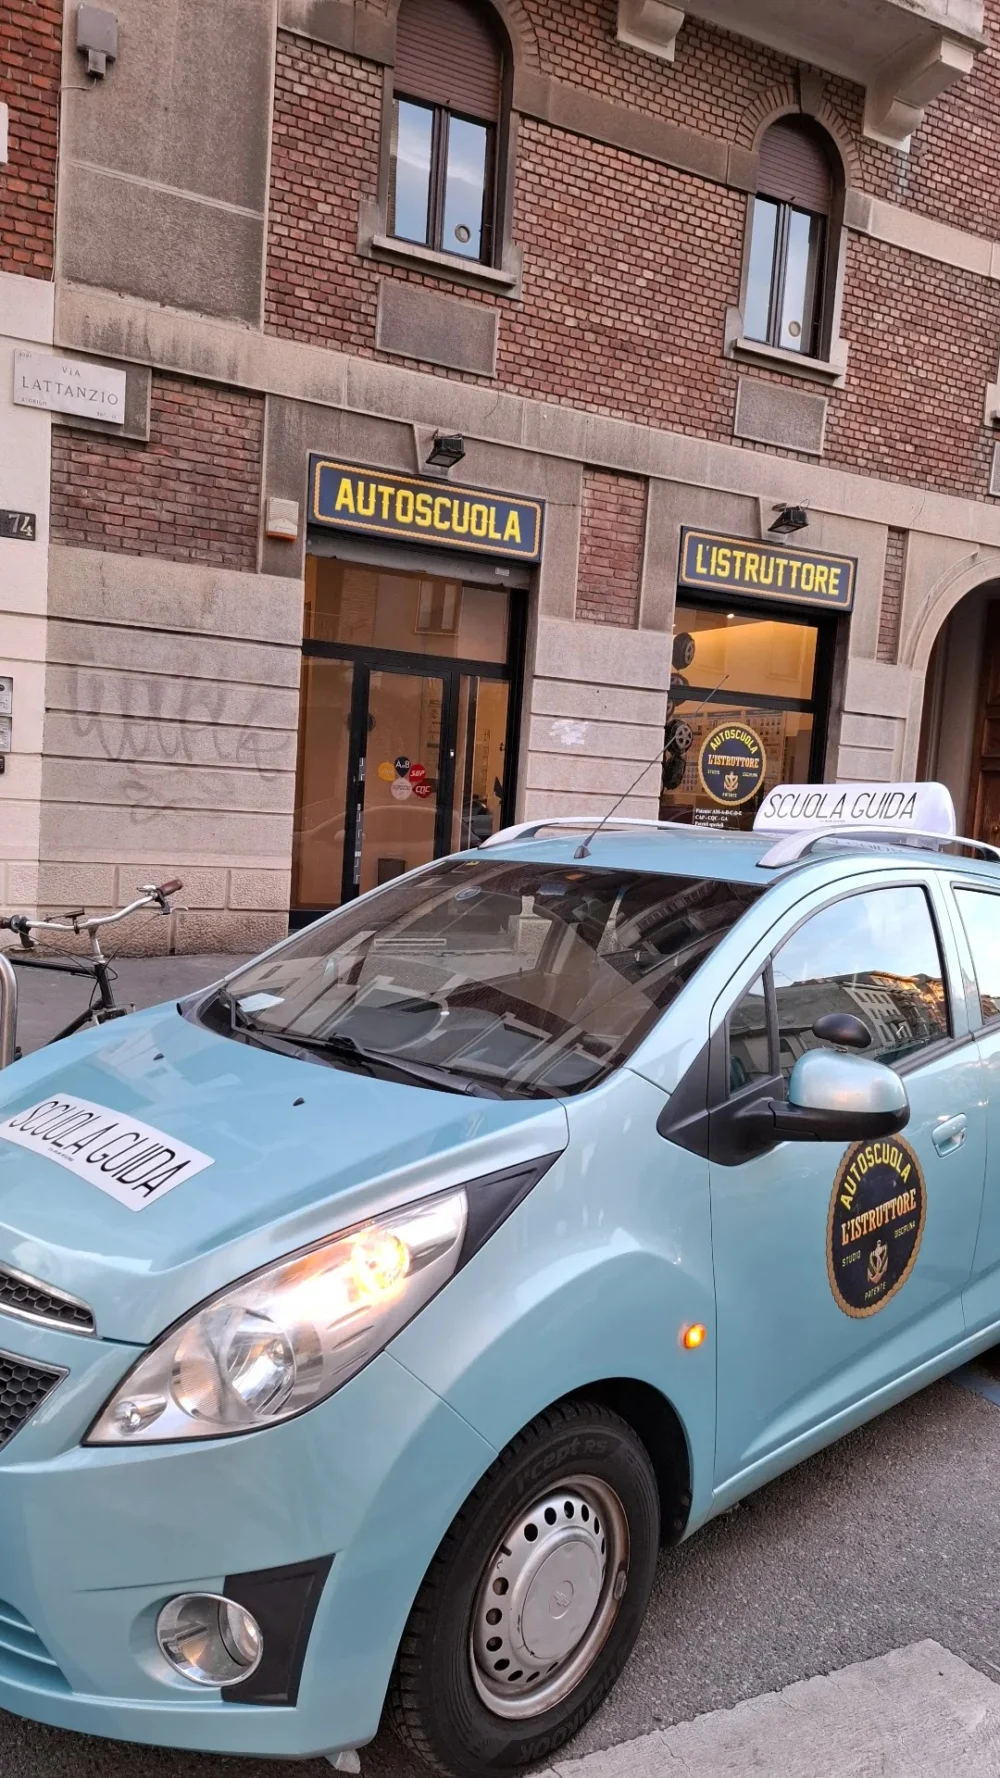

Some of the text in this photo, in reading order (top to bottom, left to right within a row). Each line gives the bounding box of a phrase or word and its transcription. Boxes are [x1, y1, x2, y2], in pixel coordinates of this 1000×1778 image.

[62, 366, 81, 377] VIA
[22, 376, 119, 405] LATTANZIO
[334, 477, 522, 544] AUTOSCUOLA
[8, 513, 33, 537] 74
[695, 543, 842, 597] L'ISTRUTTORE
[709, 729, 759, 755] AUTOSCUOLA
[707, 754, 760, 769] L'ISTRUTTORE
[763, 792, 918, 820] SCUOLA GUIDA
[9, 1100, 191, 1198] SCUOLA GUIDA
[840, 1143, 911, 1210] AUTOSCUOLA
[841, 1188, 917, 1247] L'ISTRUTTORE
[842, 1249, 861, 1267] STUDIO
